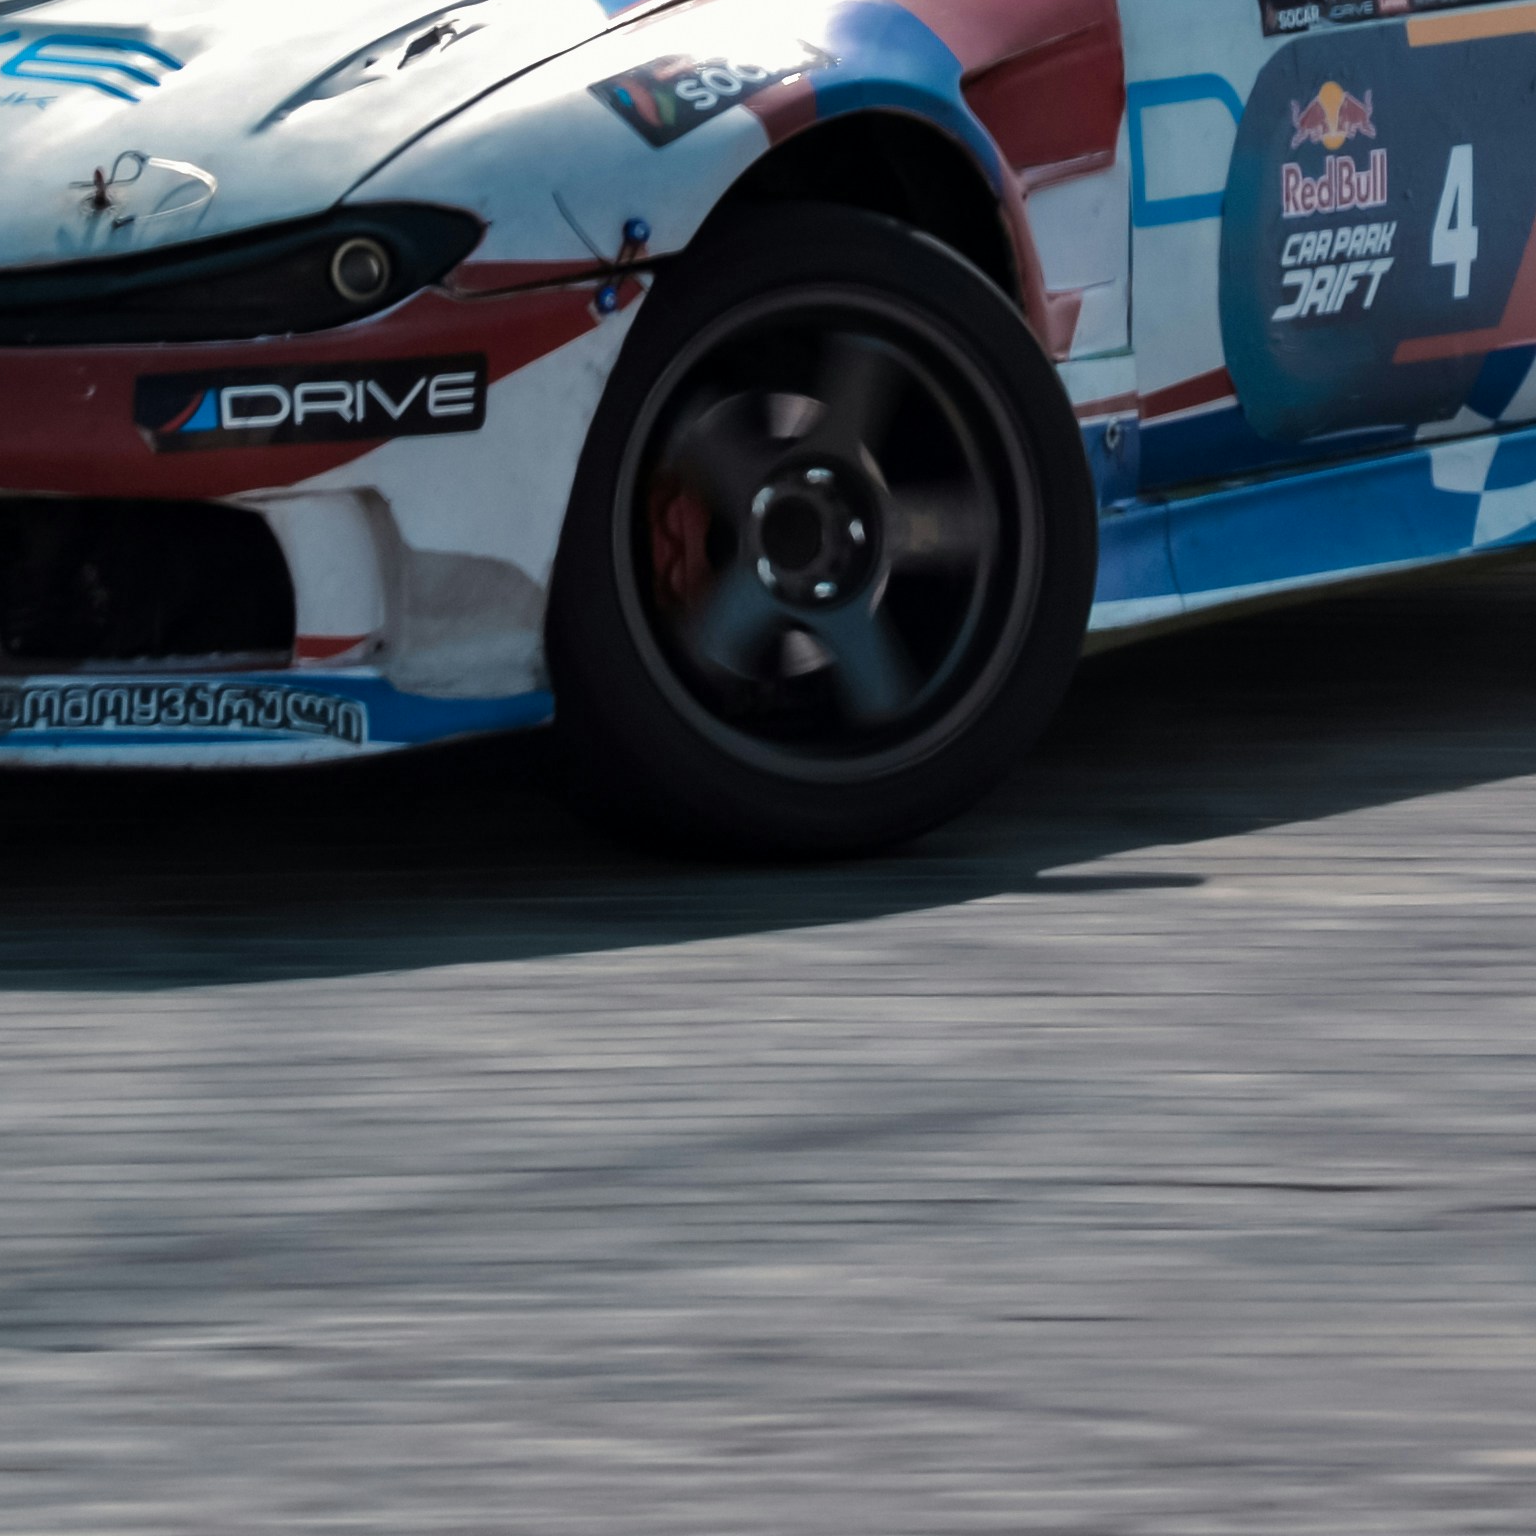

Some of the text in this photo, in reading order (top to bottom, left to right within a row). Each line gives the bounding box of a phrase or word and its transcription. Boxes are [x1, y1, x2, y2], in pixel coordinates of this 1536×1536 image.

[1281, 220, 1398, 268] CAR PARK
[1431, 143, 1479, 300] 4
[1271, 256, 1395, 322] DRIFT
[220, 370, 477, 430] DRIVE
